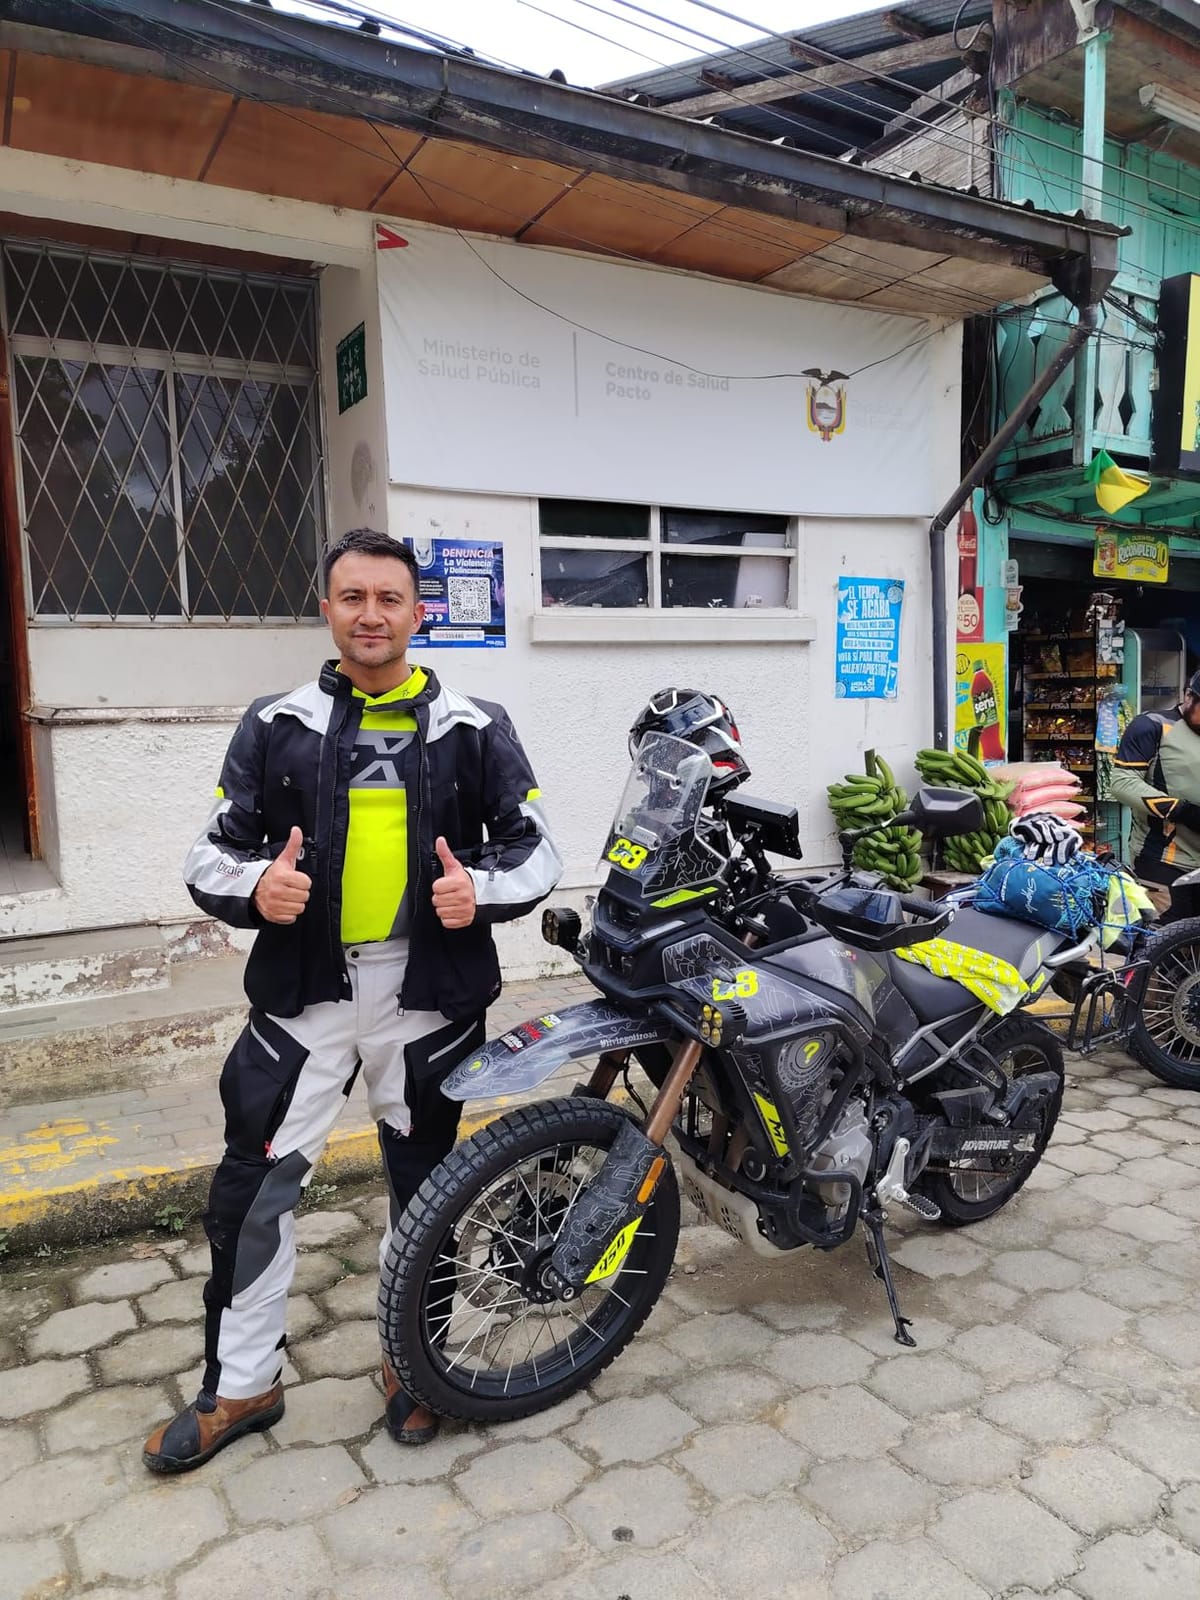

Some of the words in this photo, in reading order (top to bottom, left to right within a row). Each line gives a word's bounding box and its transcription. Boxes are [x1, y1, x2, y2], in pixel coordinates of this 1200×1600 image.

[423, 338, 513, 364] Ministerio
[519, 352, 541, 368] de
[418, 359, 469, 380] Salud
[477, 366, 541, 388] Pública
[605, 362, 660, 383] Centro
[664, 370, 683, 385] de
[687, 374, 730, 391] Salud
[605, 382, 651, 400] Pacto
[442, 548, 494, 558] DENUNCIA
[444, 558, 454, 566] La
[456, 559, 491, 567] Violencia
[847, 600, 859, 620] SE
[862, 599, 890, 618] ACABA
[960, 1139, 1011, 1151] ADVENTURE
